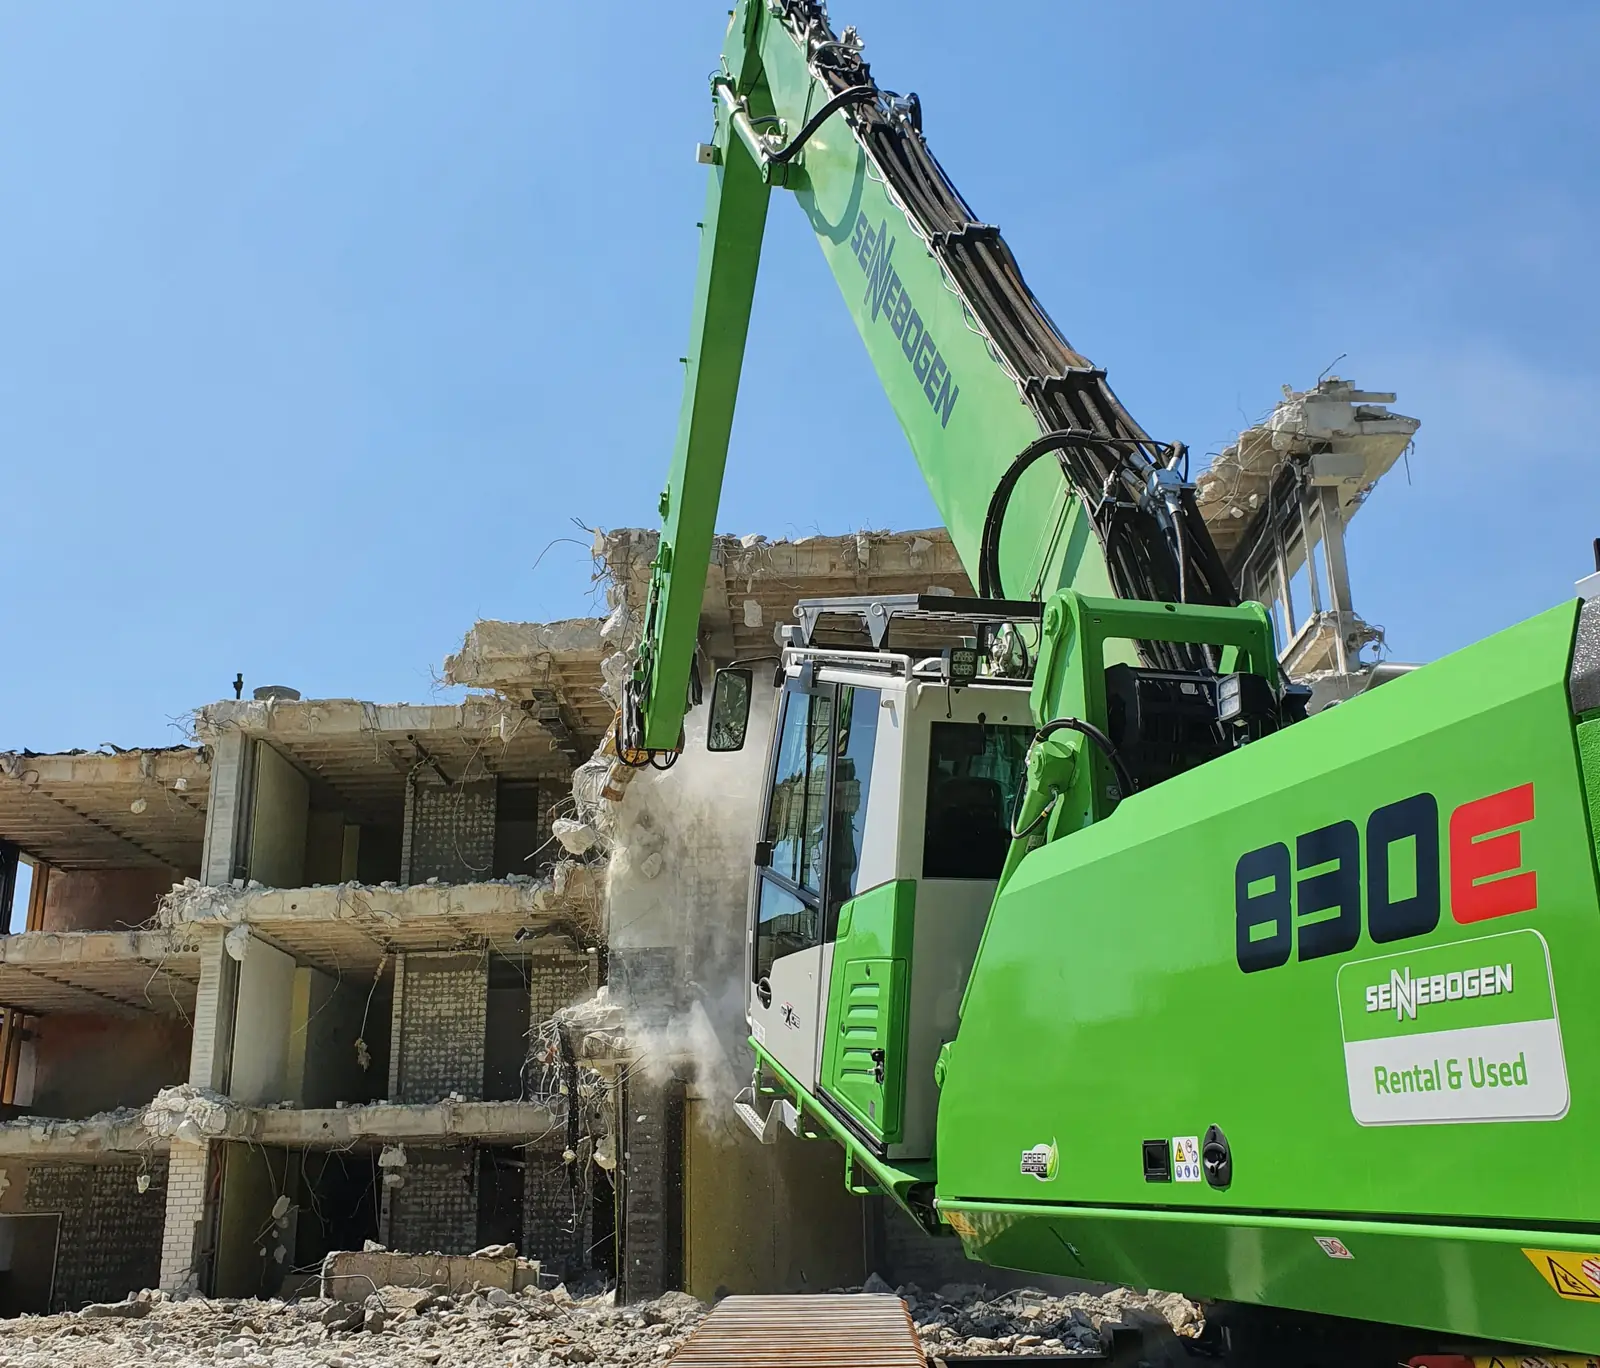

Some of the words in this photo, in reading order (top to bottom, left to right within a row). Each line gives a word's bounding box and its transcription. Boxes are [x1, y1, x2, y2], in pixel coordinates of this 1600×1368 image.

[850, 210, 959, 430] SENNEBOGEN
[1235, 782, 1537, 974] 830E
[1366, 963, 1513, 1021] SENNEBOGEN
[1374, 1059, 1441, 1095] Rental
[1446, 1058, 1463, 1090] &
[1468, 1051, 1528, 1088] Used
[1023, 1152, 1047, 1163] GREEN
